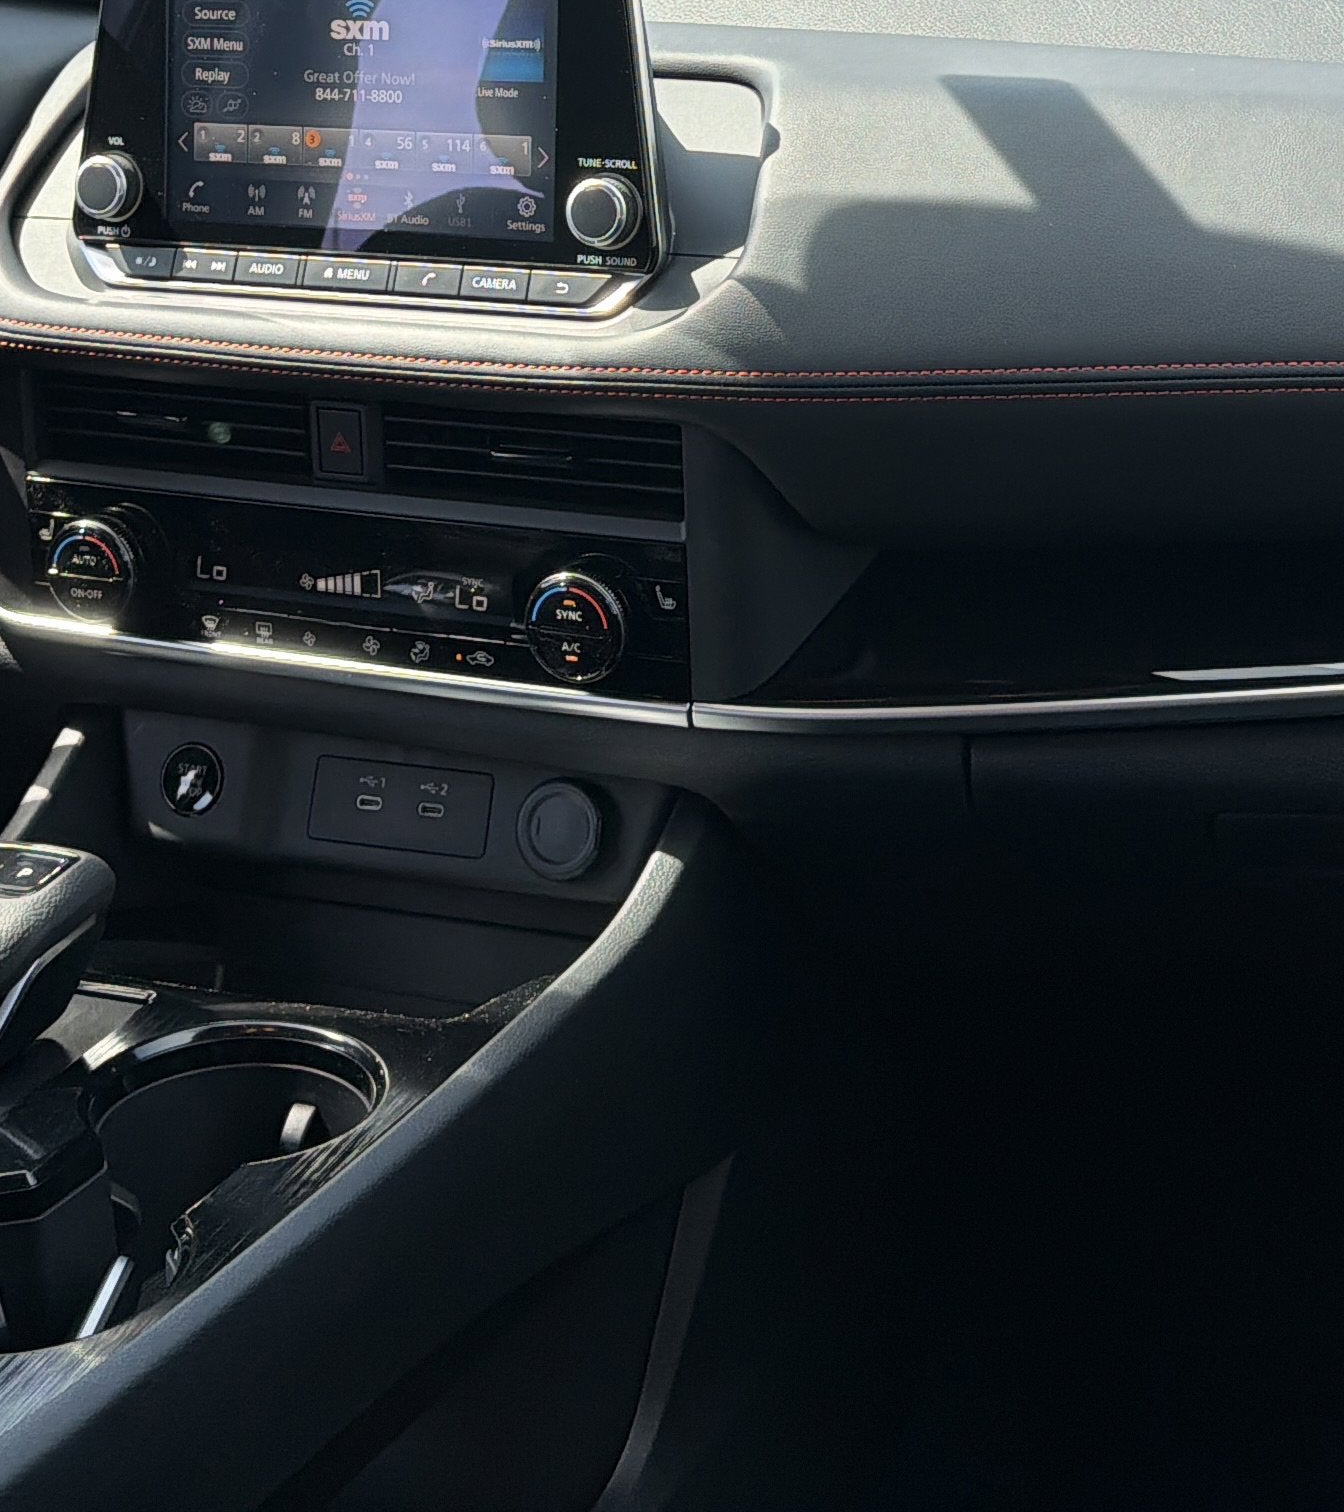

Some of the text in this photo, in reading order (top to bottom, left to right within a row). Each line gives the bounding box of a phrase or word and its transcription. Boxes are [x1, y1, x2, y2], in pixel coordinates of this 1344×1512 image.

[194, 6, 236, 21] Source
[187, 36, 244, 52] SXM Menu
[344, 43, 375, 57] Ch. 1
[195, 68, 230, 84] Replay
[304, 69, 416, 86] Great Offer Now!
[315, 88, 404, 104] 844-711-8800
[477, 88, 519, 99] Live Mode
[108, 136, 124, 146] VOL
[237, 129, 246, 143] 2
[253, 132, 261, 143] 2
[291, 131, 301, 145] 8
[396, 136, 413, 150] 56
[447, 139, 471, 152] 114
[522, 141, 529, 155] 1
[182, 202, 210, 214] Phone
[247, 205, 265, 216] AM
[298, 209, 313, 219] FM
[337, 211, 376, 222] SiriusXM
[400, 215, 429, 226] Audio
[97, 225, 120, 236] PUSH
[507, 219, 546, 234] Settings
[577, 254, 638, 267] PUSH SOUND
[248, 262, 284, 275] AUDIO
[336, 267, 371, 281] MENU
[472, 277, 517, 291] CAMERA
[71, 554, 97, 566] AUTO
[197, 555, 227, 581] Lo
[455, 585, 488, 611] Lo
[555, 609, 583, 622] SYNC
[561, 642, 581, 653] A/C
[16, 867, 33, 878] P
